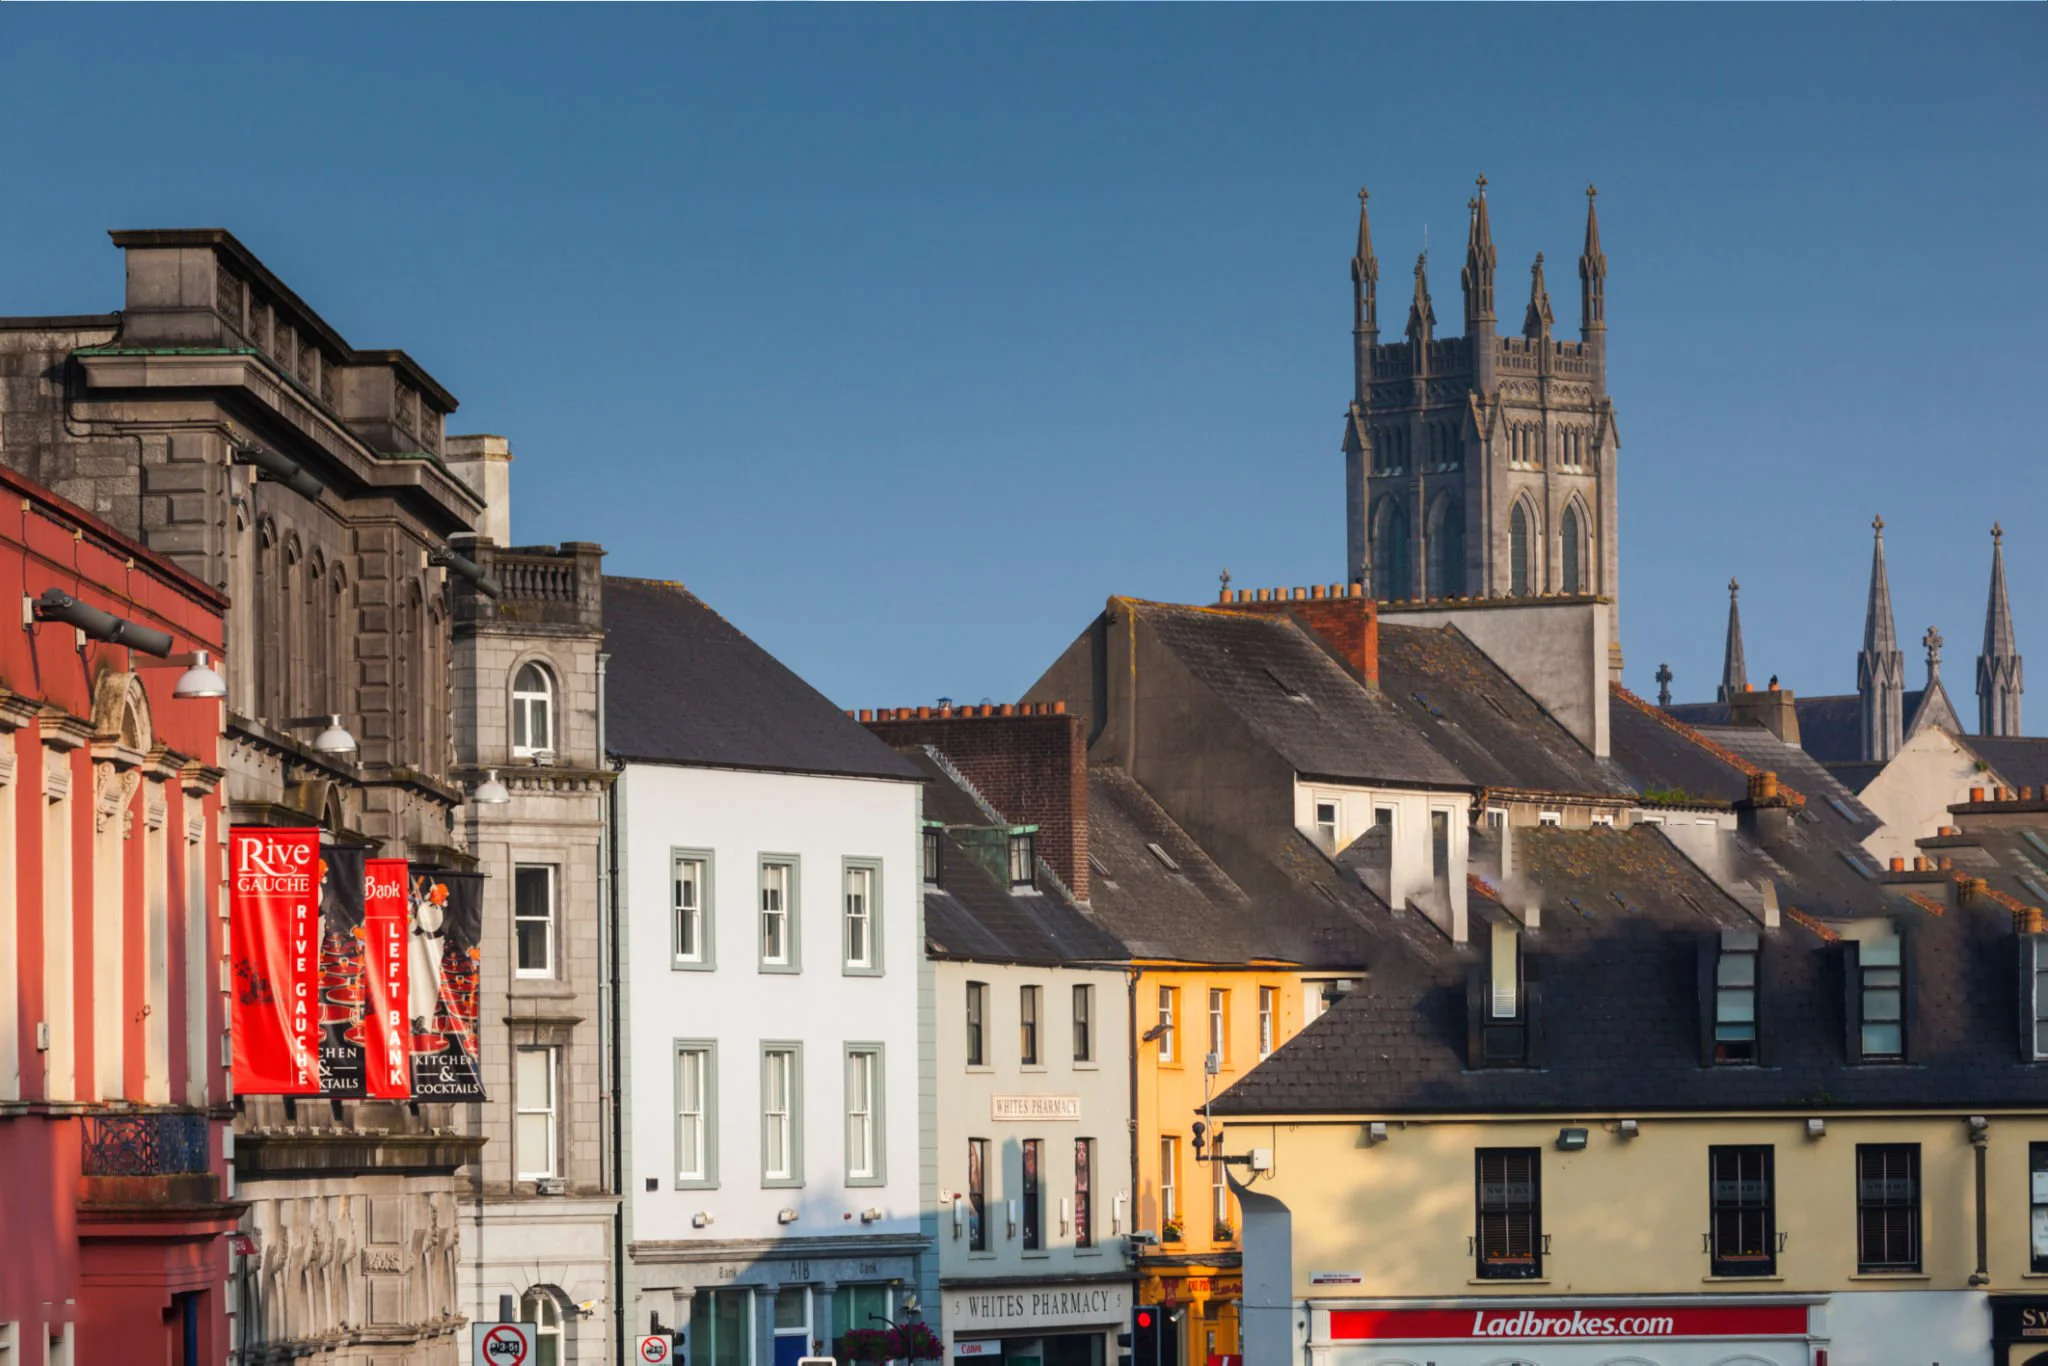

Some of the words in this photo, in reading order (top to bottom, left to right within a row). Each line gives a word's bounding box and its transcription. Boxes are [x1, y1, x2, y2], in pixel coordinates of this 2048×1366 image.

[238, 838, 310, 877] Rive
[238, 877, 310, 892] GAUCHE
[365, 876, 400, 900] Bank
[296, 904, 307, 972] RIVE
[389, 922, 400, 998] LEFT
[296, 982, 308, 1084] GAUCHE
[389, 1010, 402, 1085] BANK
[319, 1060, 334, 1077] &
[439, 1065, 456, 1082] &
[415, 1083, 479, 1094] COCKTAILS
[997, 1099, 1028, 1113] WHITES
[1032, 1099, 1078, 1114] PHARMACY
[719, 1266, 737, 1279] Bank
[790, 1261, 810, 1280] AIB
[968, 1295, 1024, 1318] WHITES
[1032, 1290, 1109, 1316] PHARMACY
[1472, 1310, 1674, 1336] Ladbrokes.com
[961, 1343, 982, 1354] Canon
